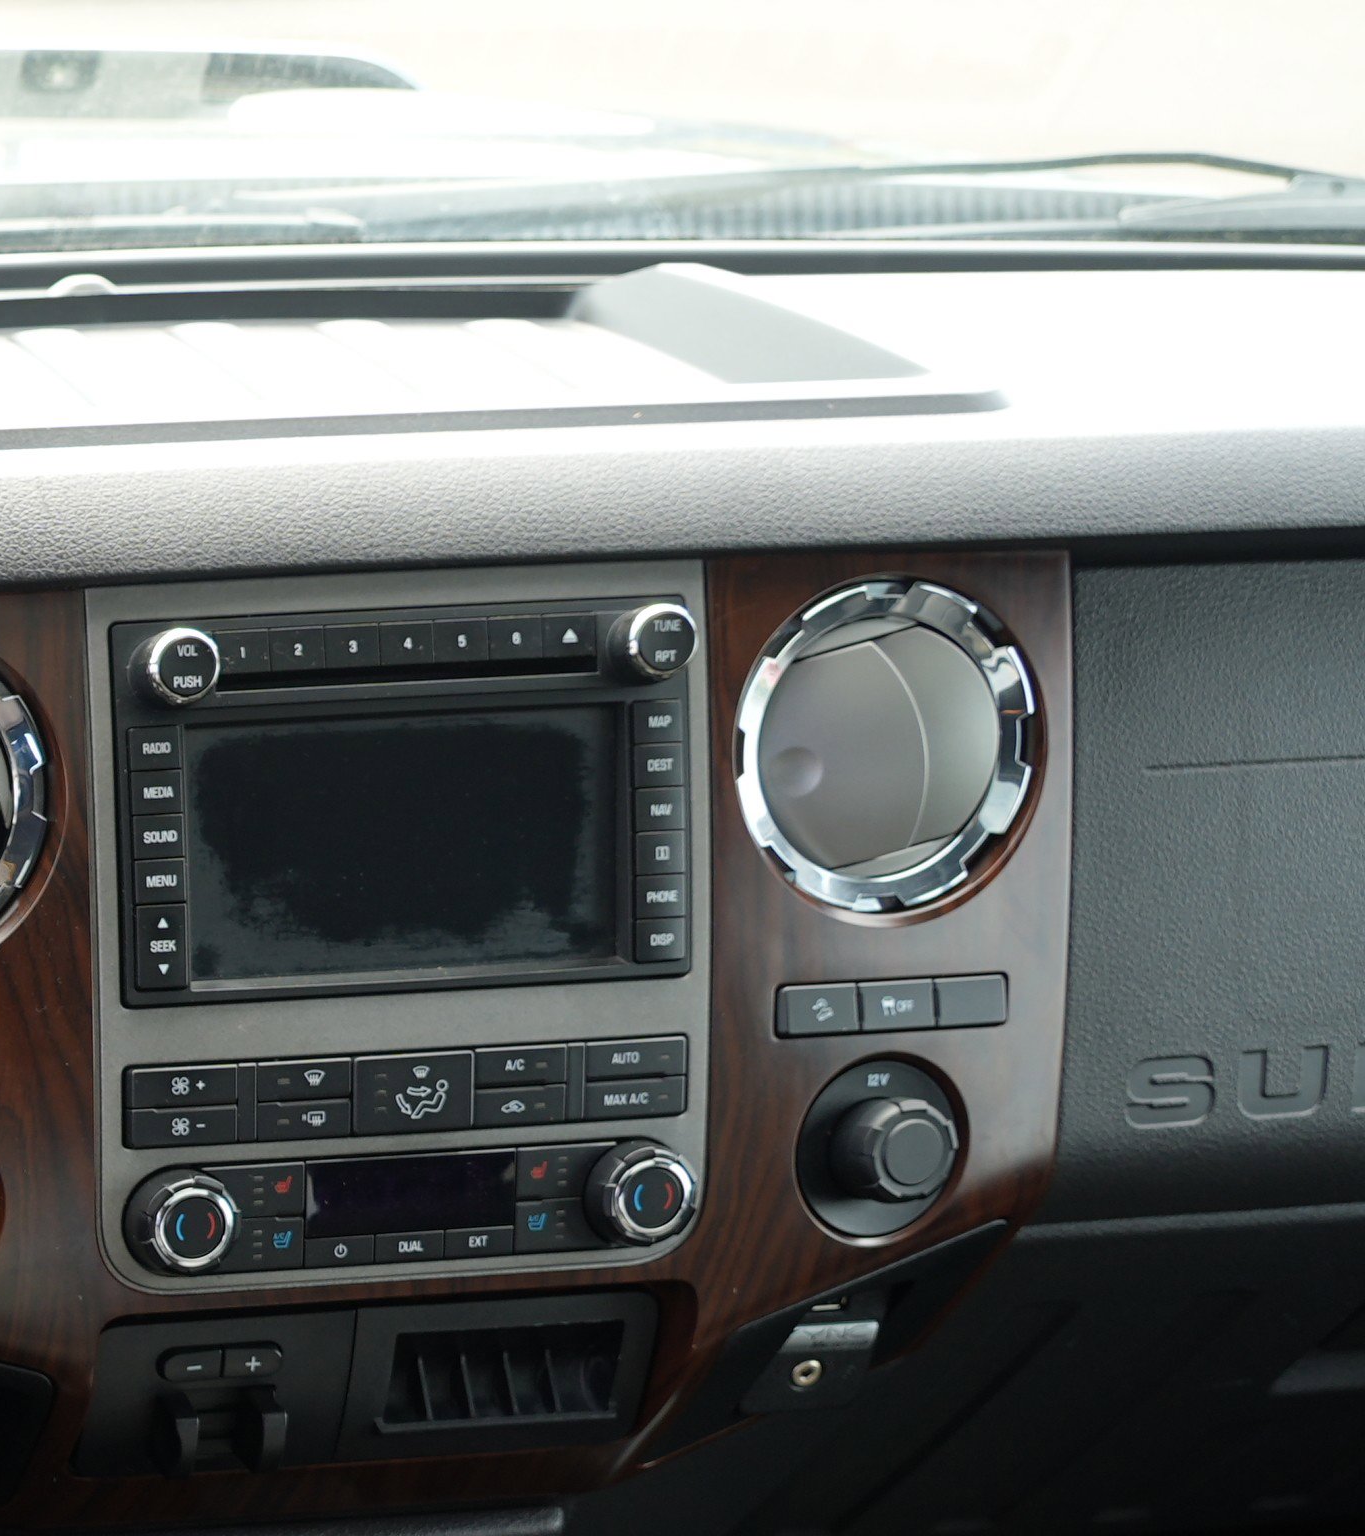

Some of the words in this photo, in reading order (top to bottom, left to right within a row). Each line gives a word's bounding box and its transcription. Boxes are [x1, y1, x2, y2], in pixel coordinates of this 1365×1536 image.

[653, 619, 681, 632] TUNE
[403, 637, 413, 650] 4
[458, 635, 467, 648] 5
[512, 632, 521, 645] 6
[177, 645, 198, 657] VOL
[240, 647, 246, 658] 1
[294, 644, 303, 656] 2
[349, 640, 358, 653] 3
[655, 649, 676, 663] RPT
[173, 675, 202, 689] PUSH
[648, 715, 672, 728] MAP
[142, 742, 171, 755] RADIO
[647, 758, 673, 772] DEST
[143, 785, 174, 799] MEDIA
[650, 803, 673, 817] NAV
[143, 829, 178, 844] SOUND
[145, 874, 177, 888] MENU
[646, 889, 678, 903] PHONE
[150, 939, 176, 953] SEEK
[650, 933, 674, 947] DISP
[896, 999, 915, 1013] OFF
[505, 1058, 525, 1072] A/C
[611, 1051, 640, 1065] AUTO
[867, 1072, 890, 1088] 12V
[1124, 1042, 1365, 1130] SU
[604, 1092, 623, 1107] MAX
[625, 1090, 648, 1106] A/C
[398, 1240, 423, 1254] DUAL
[469, 1235, 488, 1249] EXT
